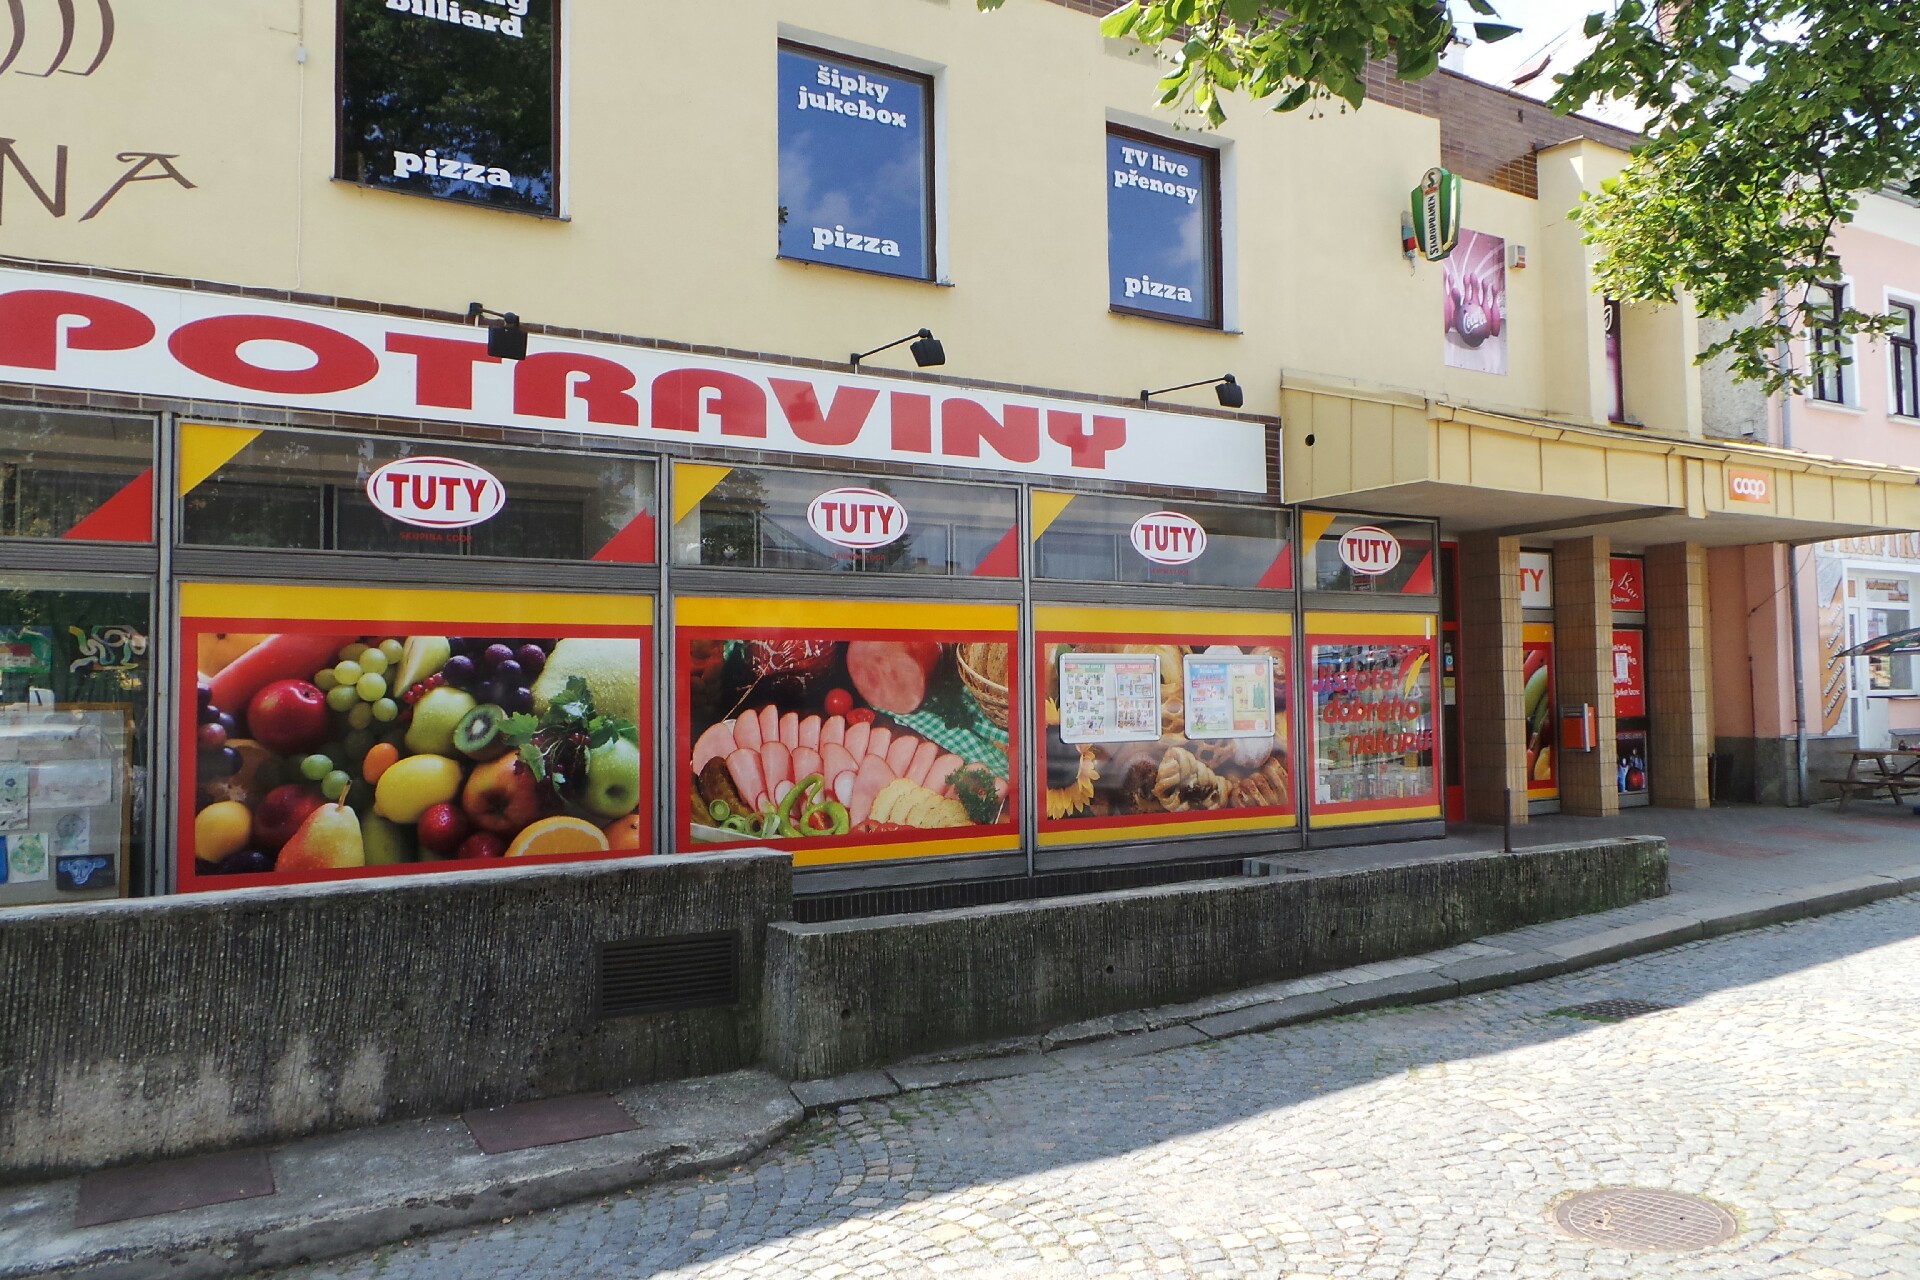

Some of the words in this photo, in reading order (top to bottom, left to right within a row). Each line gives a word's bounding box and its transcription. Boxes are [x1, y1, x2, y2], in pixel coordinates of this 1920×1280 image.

[817, 65, 889, 103] šipky
[798, 86, 906, 128] jukebox
[393, 150, 512, 188] pizza
[1122, 146, 1148, 167] TV
[1152, 153, 1188, 177] live
[1114, 169, 1198, 205] přenosy
[812, 225, 900, 257] pizza
[1124, 275, 1192, 303] pizza
[0, 289, 1127, 470] POTRAVINY
[386, 473, 487, 513] TUTY
[820, 502, 895, 535] TUTY
[1141, 524, 1196, 553] TUTY
[1346, 538, 1392, 564] TUTY
